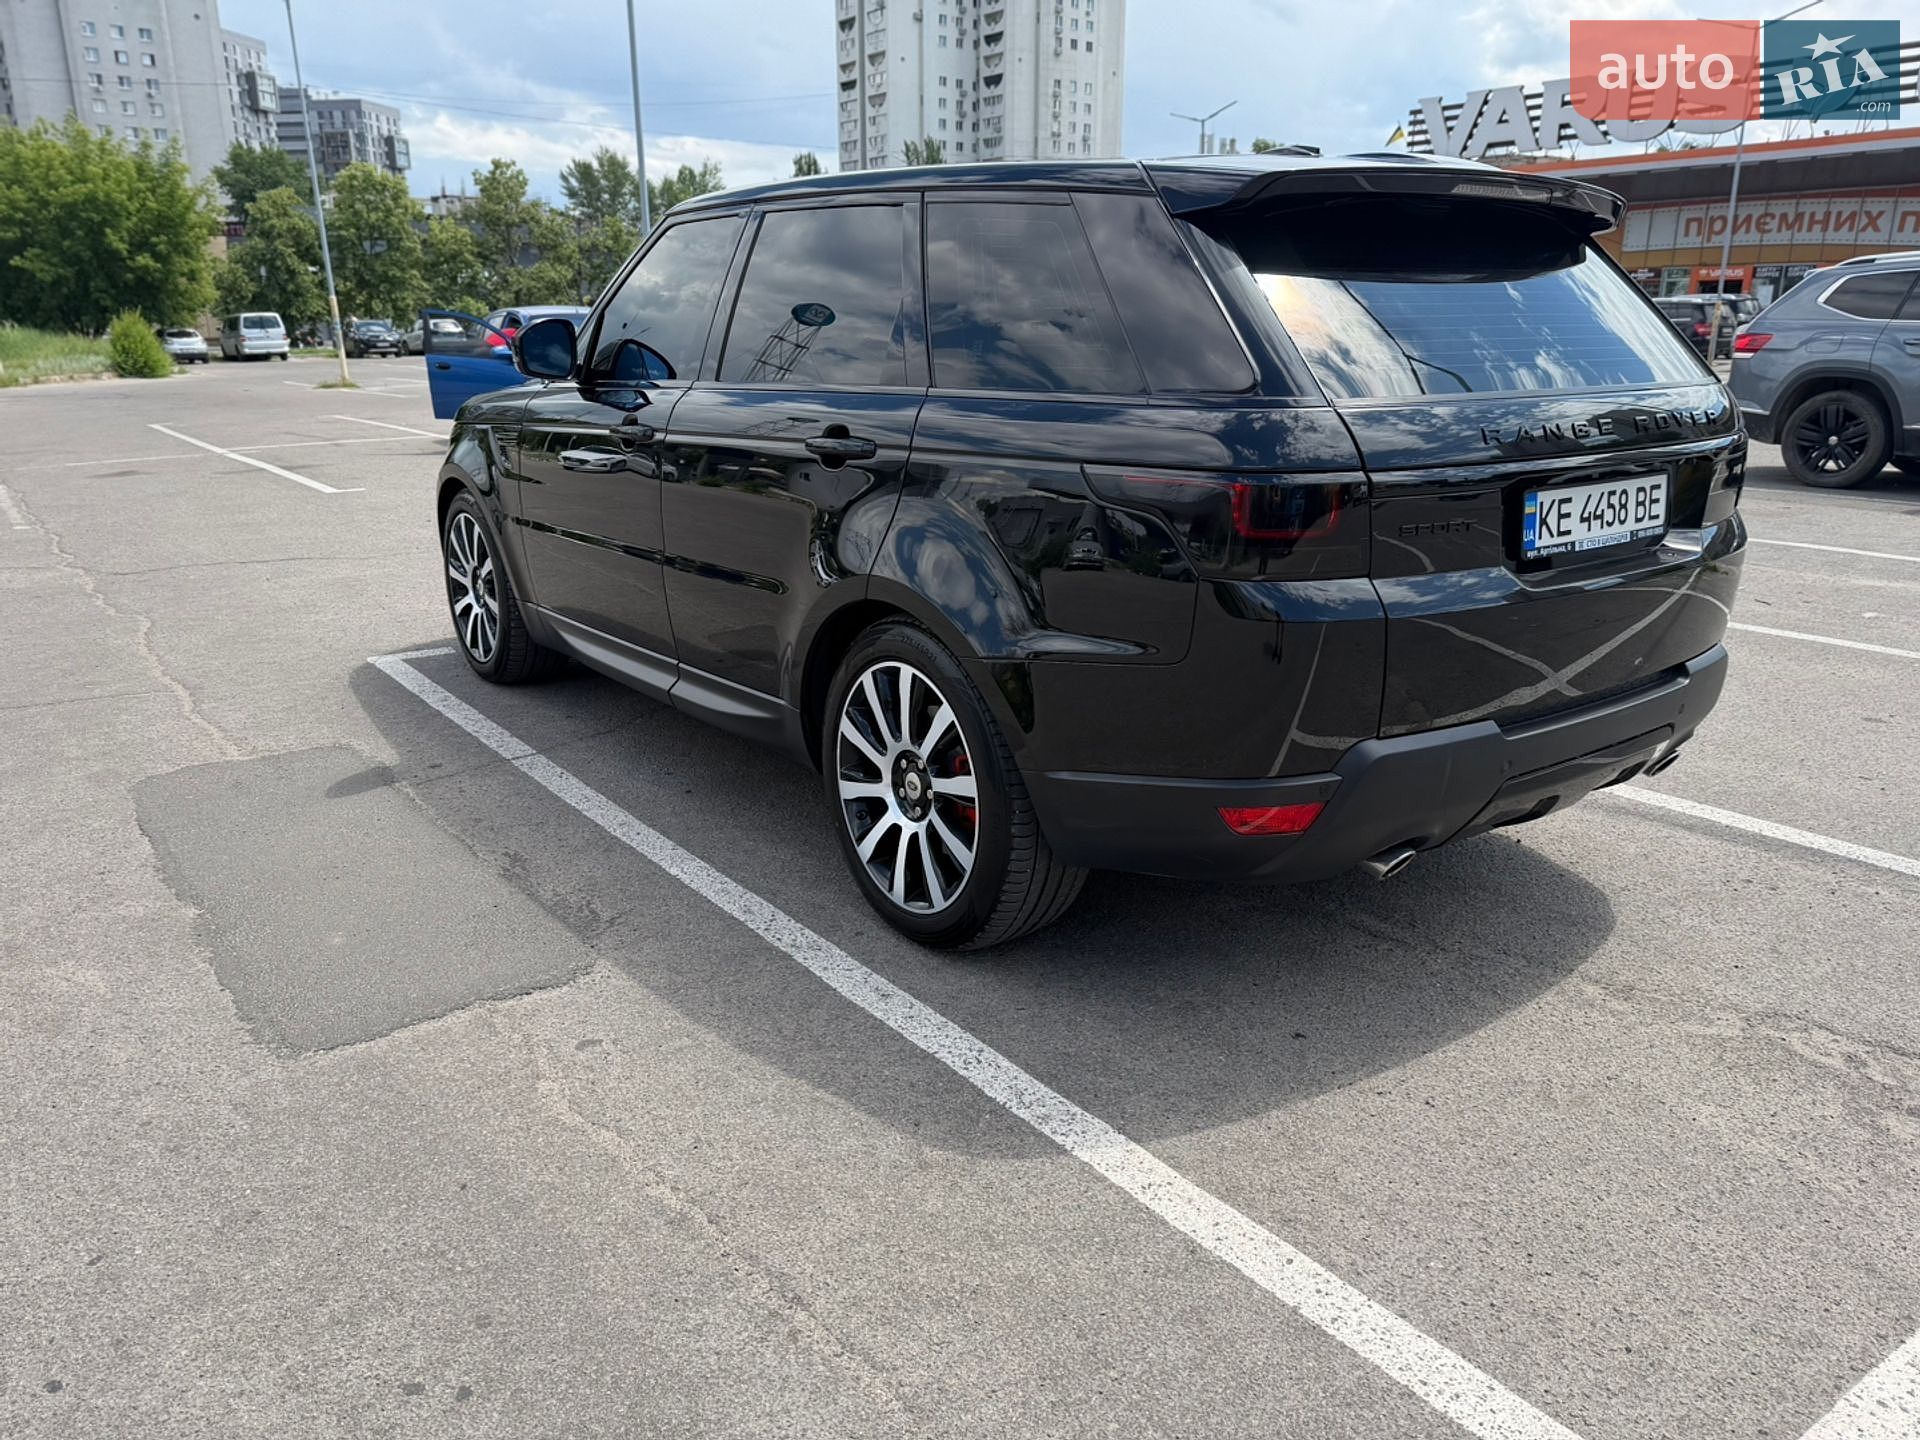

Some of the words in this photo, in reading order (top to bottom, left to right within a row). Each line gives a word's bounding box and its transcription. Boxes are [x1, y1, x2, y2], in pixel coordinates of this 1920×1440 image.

[1683, 209, 1886, 243] приємних
[1480, 418, 1614, 446] RANGE
[1633, 409, 1718, 434] ROVER
[1398, 518, 1478, 537] SPORT
[1538, 497, 1573, 540] KE
[1579, 488, 1629, 532] 4458
[1634, 483, 1662, 523] BE
[1523, 528, 1536, 542] UA
